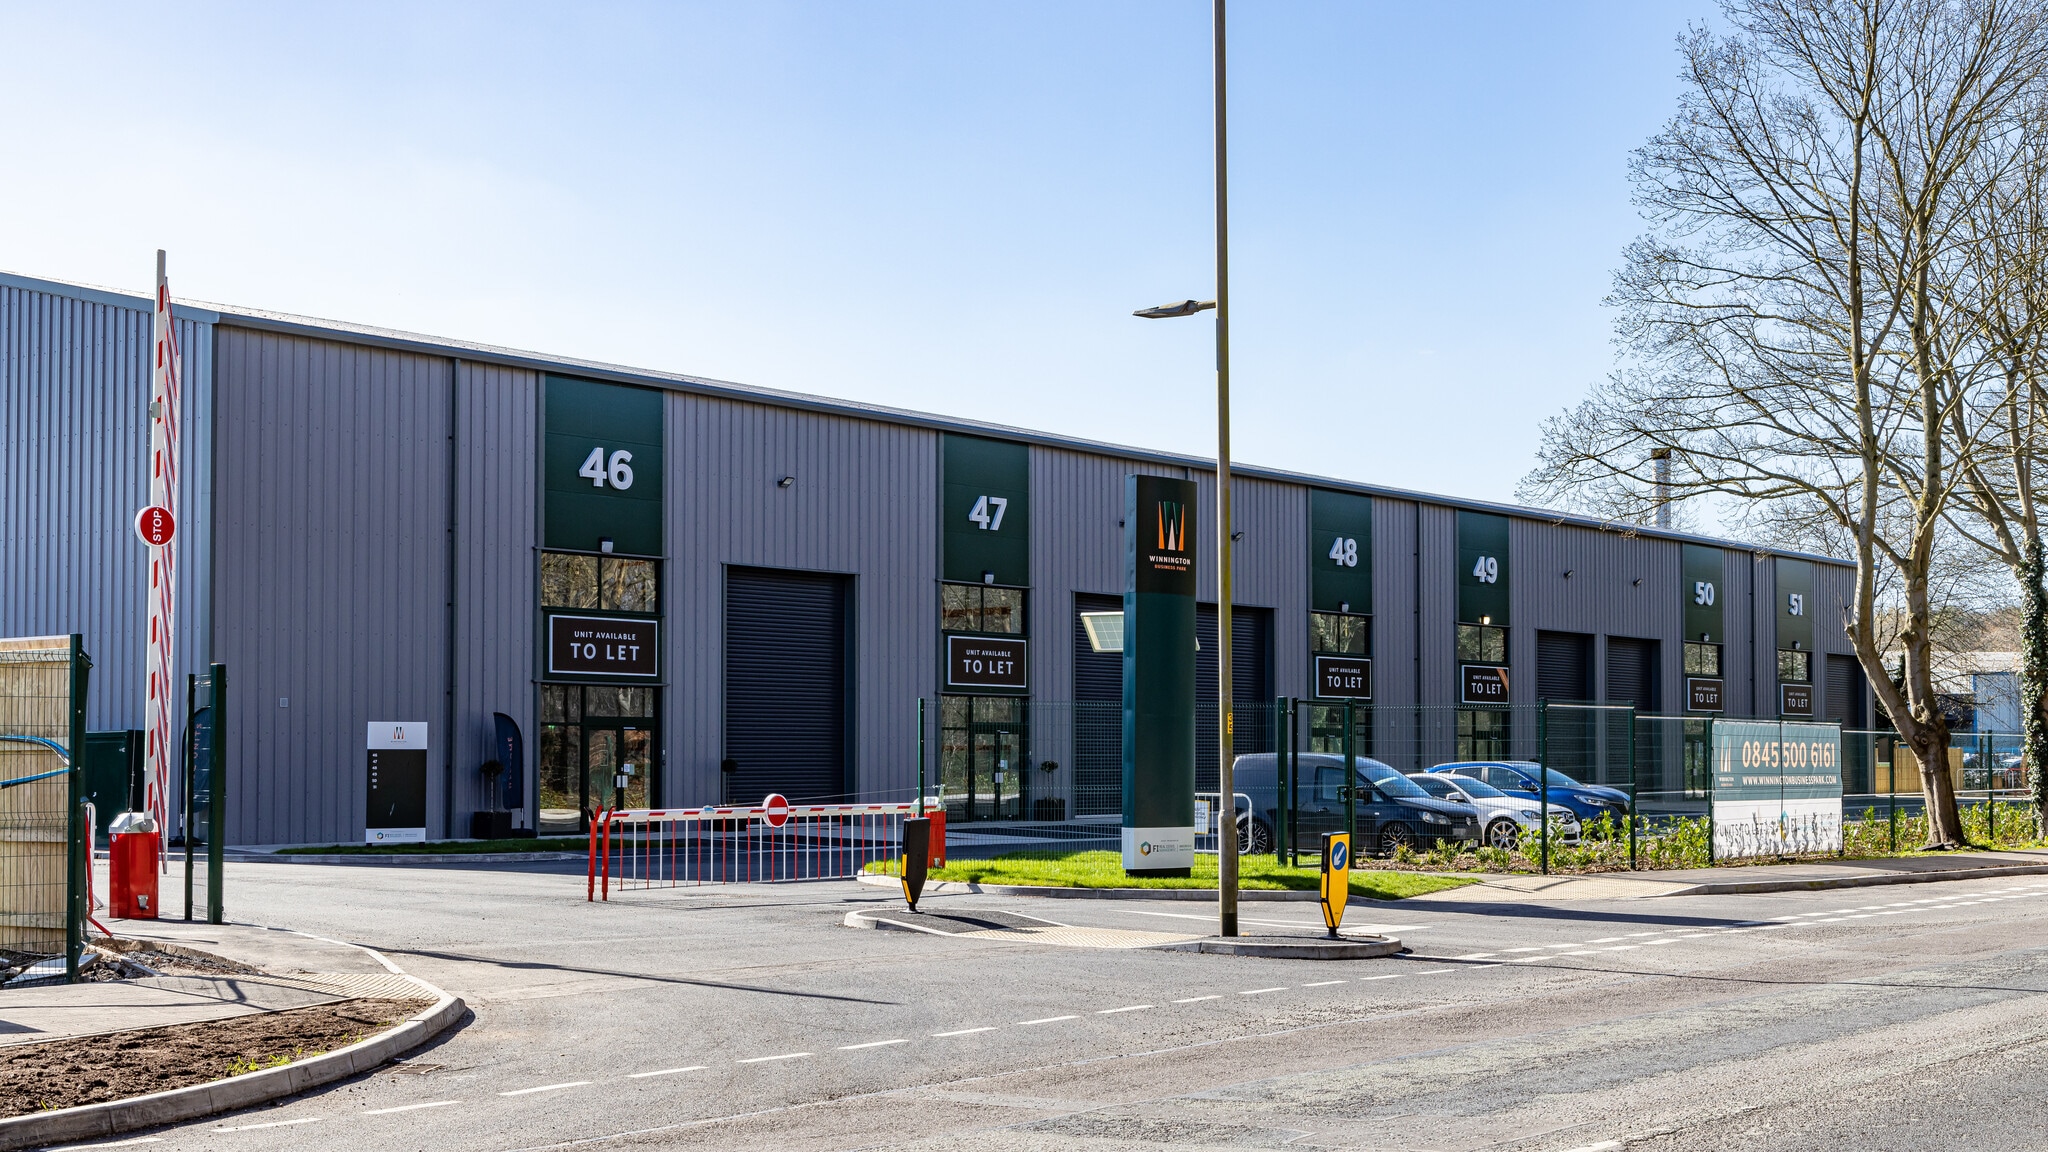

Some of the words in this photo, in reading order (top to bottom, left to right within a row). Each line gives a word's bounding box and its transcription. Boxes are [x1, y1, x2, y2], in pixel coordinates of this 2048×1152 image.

[578, 447, 634, 491] 46
[968, 495, 1008, 531] 47
[152, 510, 162, 542] STOP
[1149, 555, 1191, 565] WINNINGTON
[1328, 537, 1358, 568] 48
[1473, 556, 1498, 584] 49
[1695, 581, 1715, 606] 50
[1788, 593, 1803, 616] 51
[596, 632, 637, 641] AVAILABLE
[570, 642, 597, 660] TO
[606, 644, 640, 661] LET
[982, 650, 1011, 658] AVAILABLE
[963, 659, 983, 674] TO
[989, 660, 1014, 675] LET
[1327, 675, 1341, 688] TO
[1345, 676, 1363, 689] LET
[1471, 682, 1484, 694] TO
[1486, 683, 1502, 695] LET
[1694, 692, 1704, 703] TO
[1706, 693, 1718, 703] LET
[1787, 697, 1796, 707] TO
[1797, 698, 1808, 708] LET
[1742, 740, 1779, 768] 0845
[1783, 742, 1807, 768] 500
[1810, 742, 1835, 768] 6161
[1742, 775, 1837, 785] WWW.WINNINGTONBUSINESSPARK.COM
